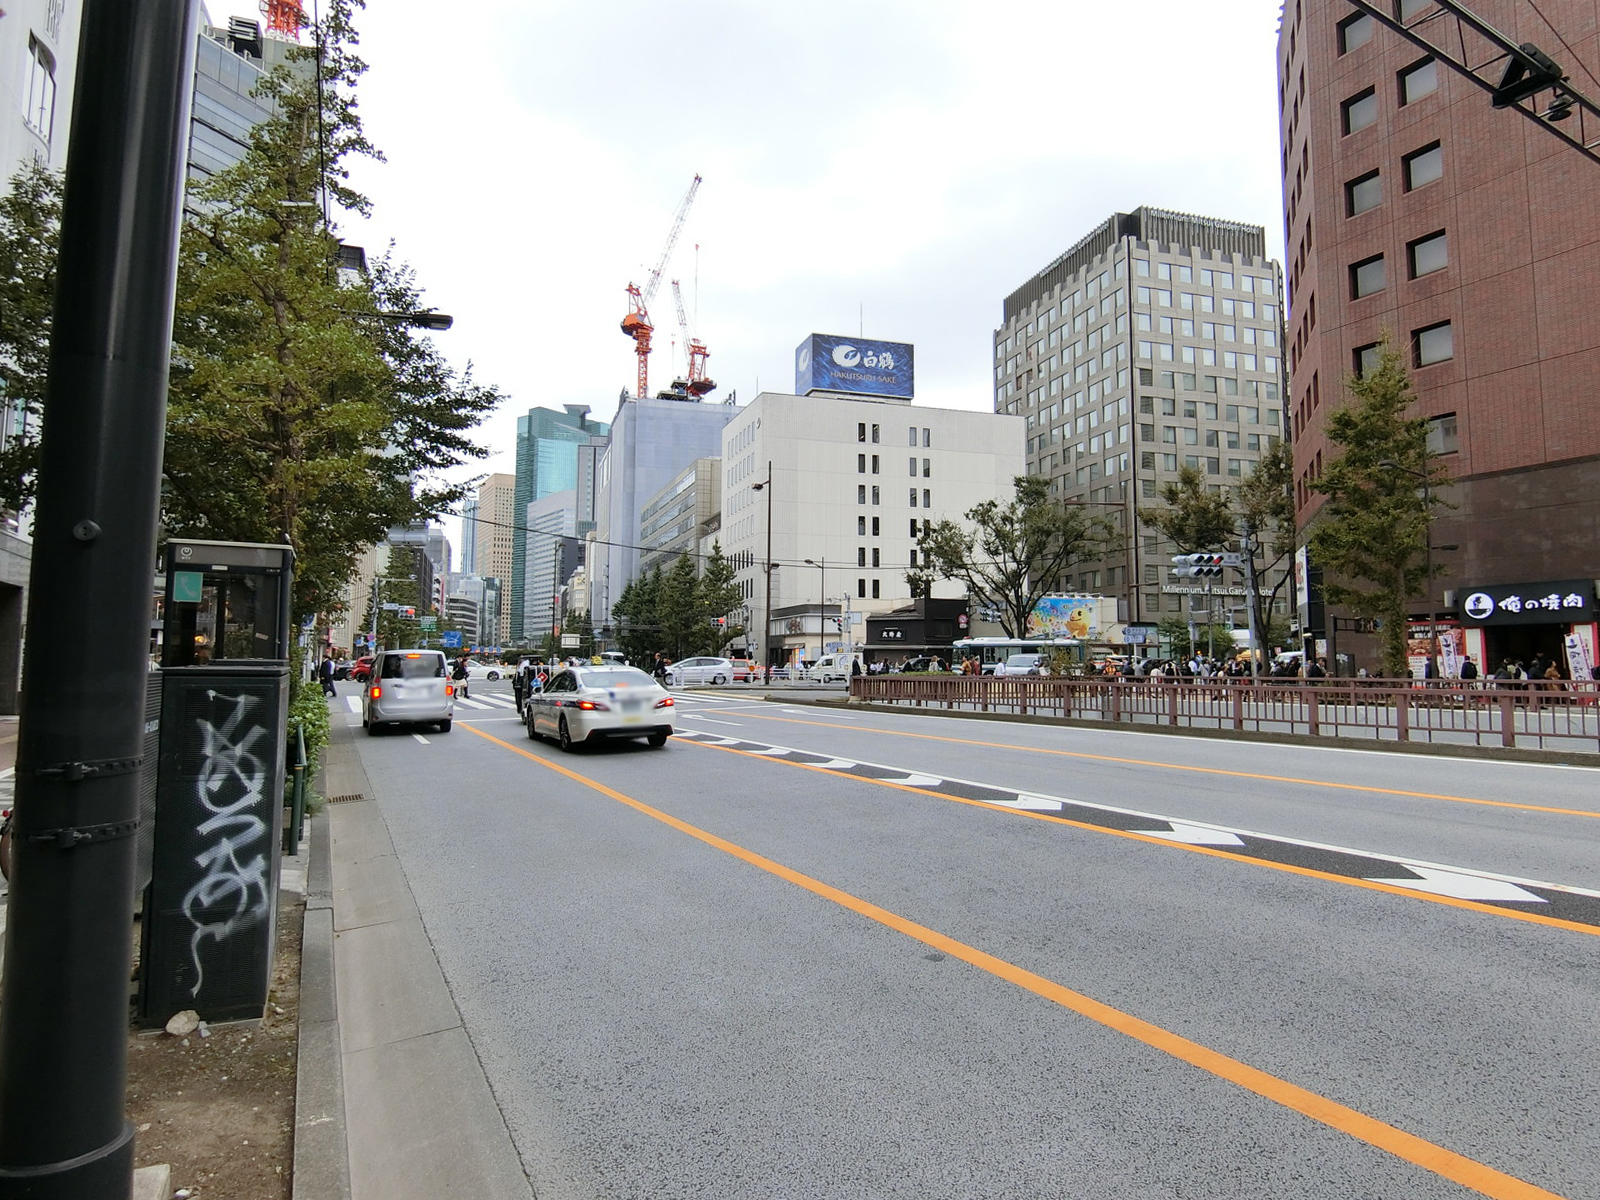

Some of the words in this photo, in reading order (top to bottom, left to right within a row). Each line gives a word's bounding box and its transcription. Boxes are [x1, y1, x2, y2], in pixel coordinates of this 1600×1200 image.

[863, 350, 894, 370] 白鶴
[830, 371, 876, 381] HAKUTSURU
[877, 375, 897, 384] SAKE
[1498, 593, 1584, 613] 俺の焼肉
